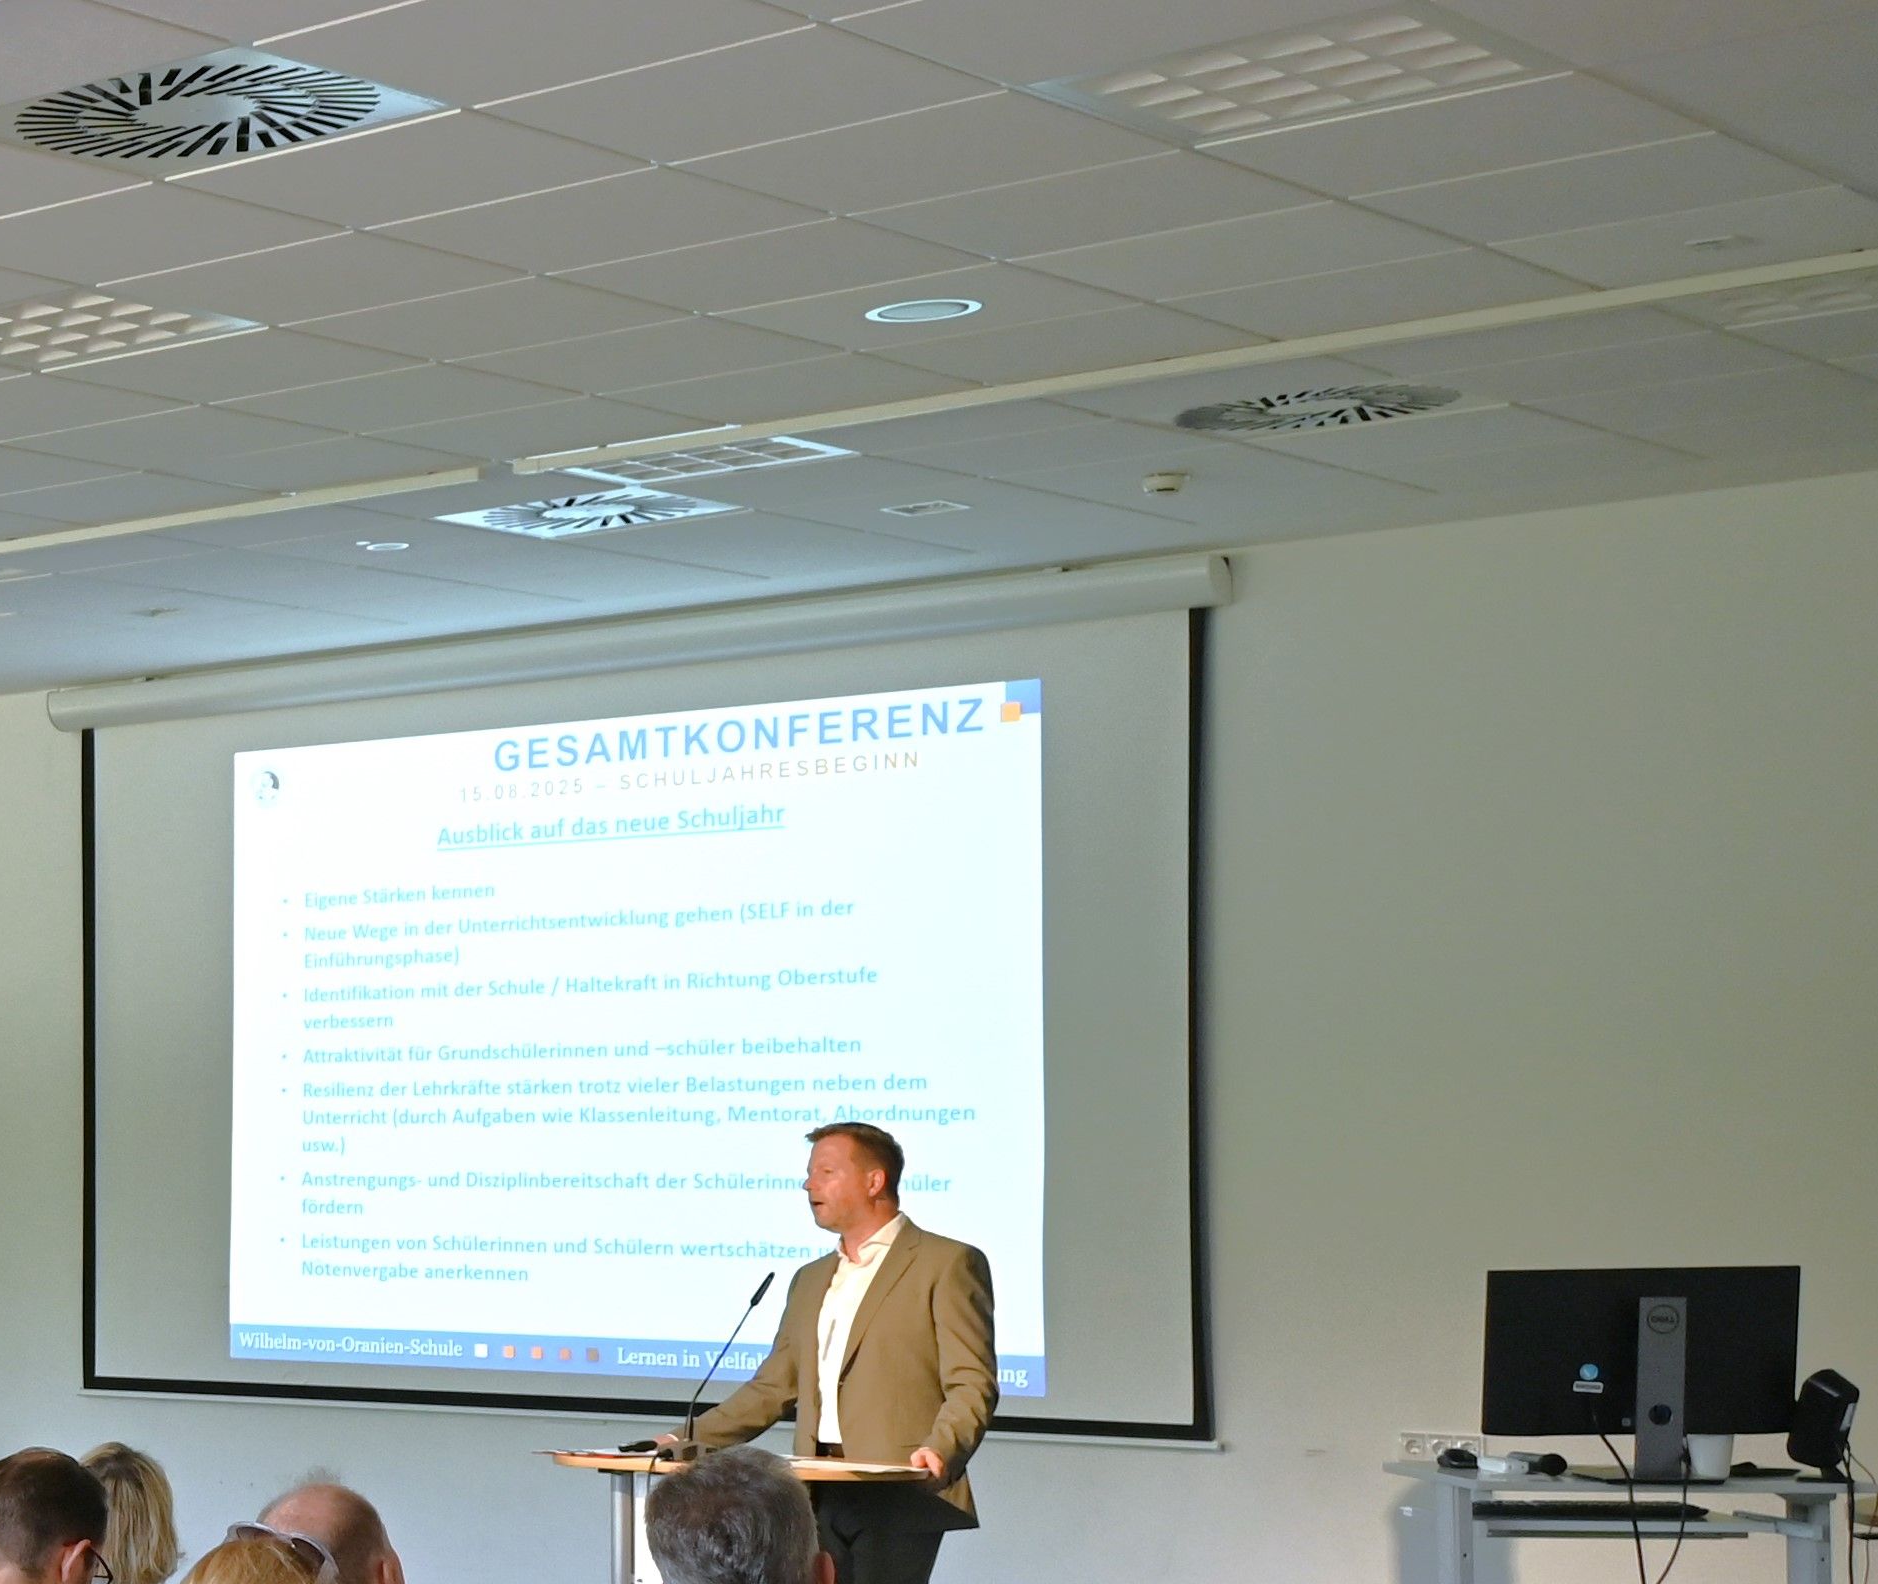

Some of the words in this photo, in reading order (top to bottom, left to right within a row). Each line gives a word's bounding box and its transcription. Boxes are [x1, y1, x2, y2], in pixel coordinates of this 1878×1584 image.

[494, 698, 984, 772] GESAMTKONFERENZ
[461, 778, 582, 802] 15.08.2025
[620, 751, 919, 790] SCHULJAHRESBEGINN
[438, 822, 524, 845] Ausblick
[531, 817, 564, 839] auf
[572, 813, 607, 837] das
[616, 816, 670, 834] neue
[677, 804, 785, 832] Schuljahr
[305, 893, 357, 911] Eigene
[363, 888, 426, 904] Stärken
[432, 886, 495, 900] kennen
[305, 927, 346, 940] Neue
[353, 924, 398, 942] Wege
[405, 924, 419, 936] in
[425, 920, 453, 936] der
[459, 910, 669, 933] Unterrichtsentwicklung
[675, 906, 733, 928] gehen
[740, 902, 789, 923] (SELF
[797, 903, 814, 917] in
[821, 900, 853, 916] der
[304, 945, 459, 970] Einführungsphase)
[305, 986, 415, 1002] Identifikation
[421, 984, 448, 998] mit
[454, 982, 482, 997] der
[489, 979, 545, 996] Schule
[566, 975, 657, 992] Haltekraft
[664, 974, 681, 990] in
[687, 972, 771, 992] Richtung
[778, 966, 878, 986] Oberstufe
[304, 1014, 394, 1030] verbessern
[304, 1048, 402, 1063] Attraktivität
[408, 1046, 432, 1061] für
[438, 1043, 608, 1060] Grundschülerinnen
[615, 1040, 649, 1057] und
[742, 1036, 861, 1055] beibehalten
[303, 1082, 373, 1097] Resilienz
[380, 1081, 407, 1096] der
[413, 1080, 501, 1096] Lehrkräfte
[507, 1080, 572, 1095] stärken
[579, 1080, 621, 1094] trotz
[627, 1077, 679, 1093] vieler
[686, 1076, 805, 1096] Belastungen
[813, 1074, 876, 1091] neben
[883, 1073, 927, 1090] dem
[303, 1109, 387, 1125] Unterricht
[393, 1108, 447, 1128] (durch
[453, 1108, 536, 1128] Aufgaben
[542, 1109, 573, 1123] wie
[580, 1107, 720, 1127] Klassenleitung,
[728, 1106, 826, 1124] Mentorat,
[833, 1104, 976, 1125] Abordnungen
[303, 1136, 345, 1155] usw.)
[302, 1172, 421, 1191] Anstrengungs-
[428, 1172, 460, 1187] und
[466, 1172, 649, 1191] Disziplinbereitschaft
[656, 1173, 687, 1189] der
[302, 1199, 364, 1215] fördern
[302, 1233, 391, 1253] Leistungen
[397, 1240, 427, 1250] von
[433, 1235, 547, 1253] Schülerinnen
[554, 1238, 588, 1253] und
[594, 1238, 673, 1255] Schülern
[680, 1241, 811, 1258] wertschätzen
[425, 1264, 528, 1280] anerkennen
[239, 1332, 463, 1358] Wilhelm-von-Oranien-Schule
[617, 1347, 678, 1367] Lernen
[683, 1349, 700, 1368] in
[705, 1351, 763, 1371] Vielfal
